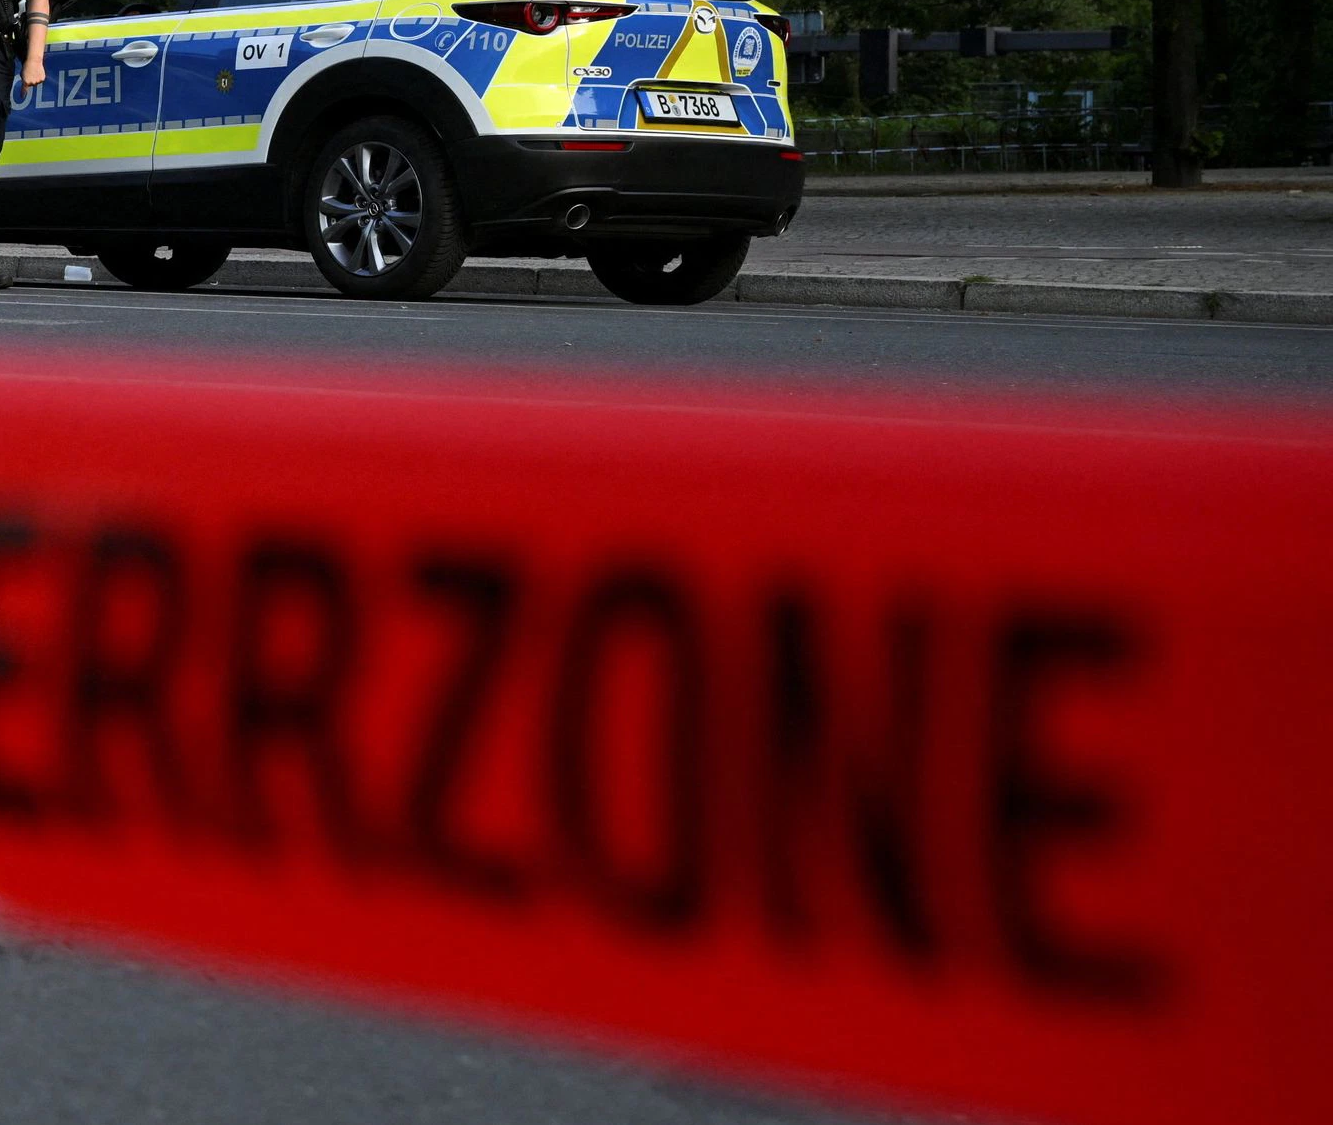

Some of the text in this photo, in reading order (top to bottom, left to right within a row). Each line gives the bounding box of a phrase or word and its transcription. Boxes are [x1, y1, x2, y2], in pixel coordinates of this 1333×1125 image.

[242, 42, 285, 61] OV 1
[466, 30, 508, 53] 110
[615, 32, 671, 50] POLIZEI
[572, 67, 611, 78] CX-30
[10, 65, 122, 111] OLIZEI
[656, 94, 671, 115] B
[678, 95, 720, 117] 7368
